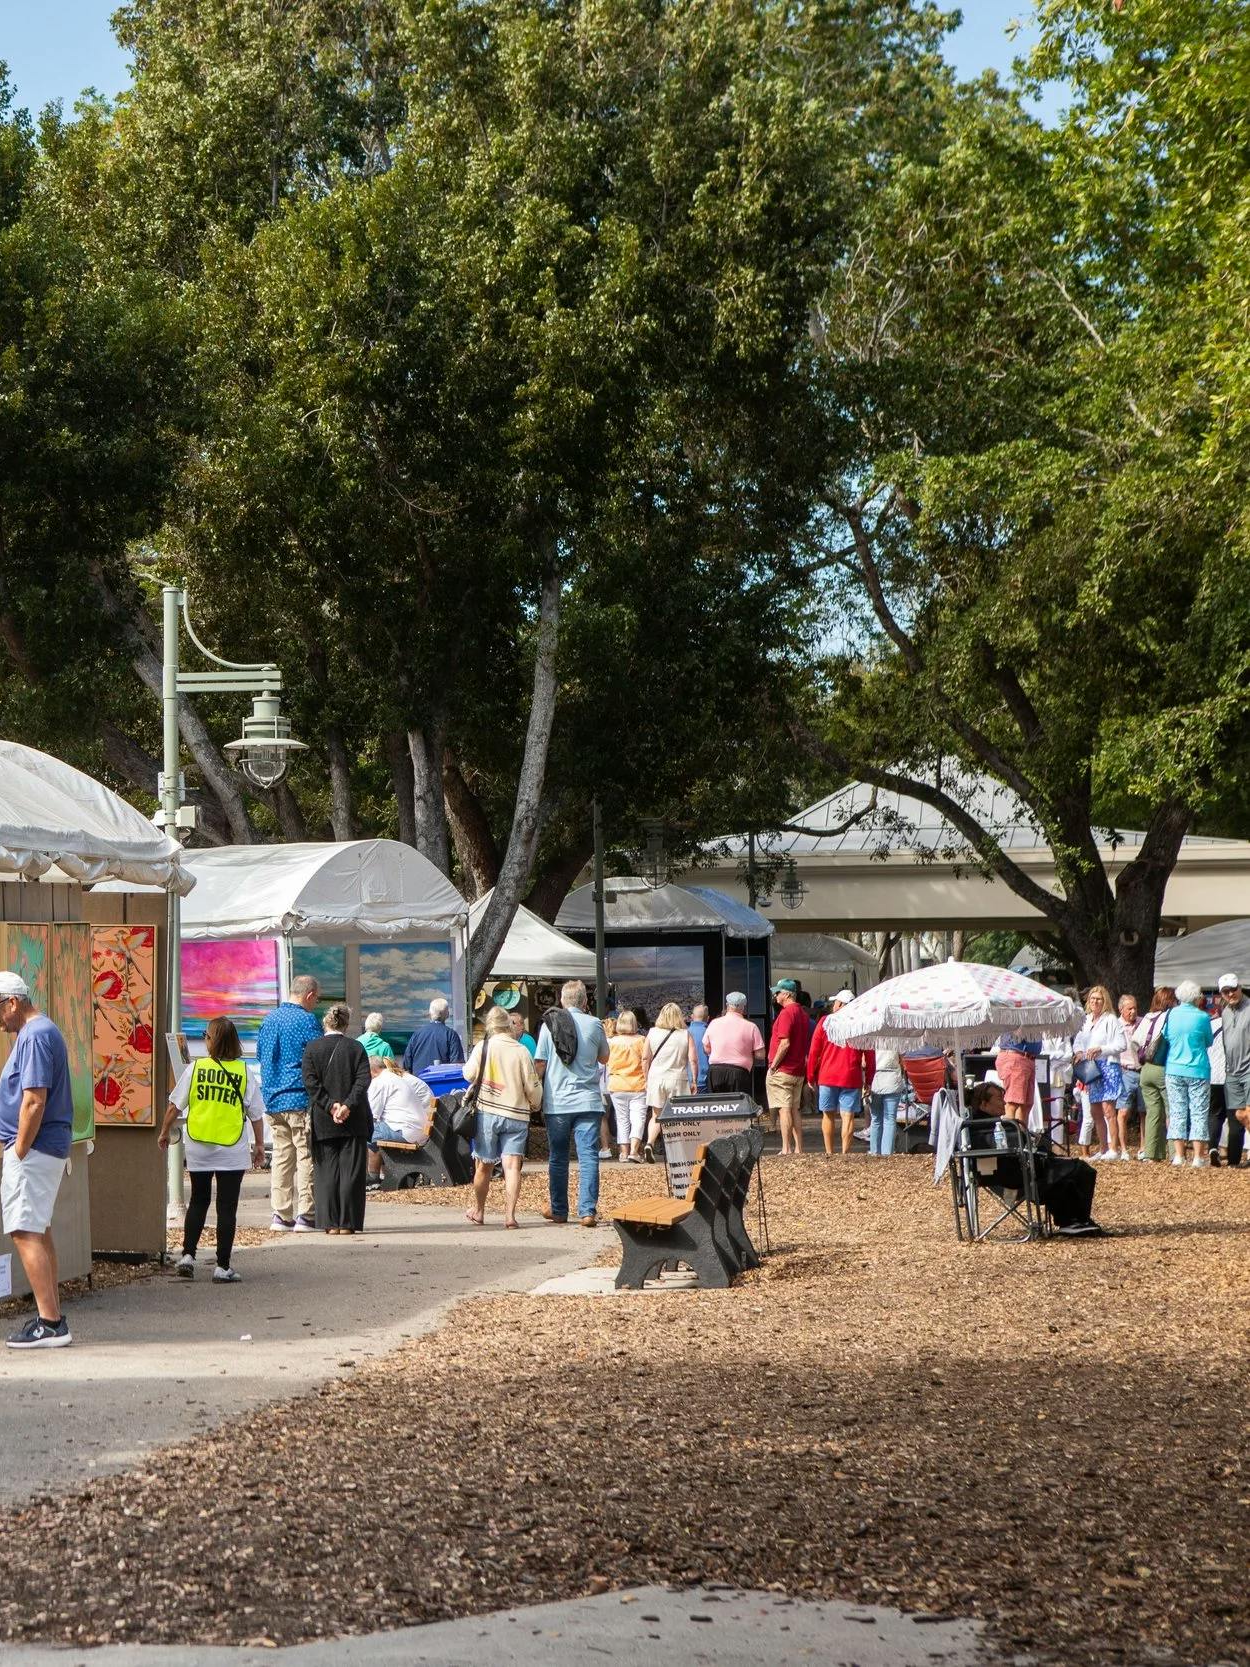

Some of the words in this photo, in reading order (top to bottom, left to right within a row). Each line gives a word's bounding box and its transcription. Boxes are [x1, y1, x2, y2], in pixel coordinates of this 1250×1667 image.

[197, 1068, 242, 1088] BOOTH
[197, 1084, 238, 1105] SITTER
[672, 1106, 708, 1114] TRASH
[710, 1104, 739, 1112] ONLY
